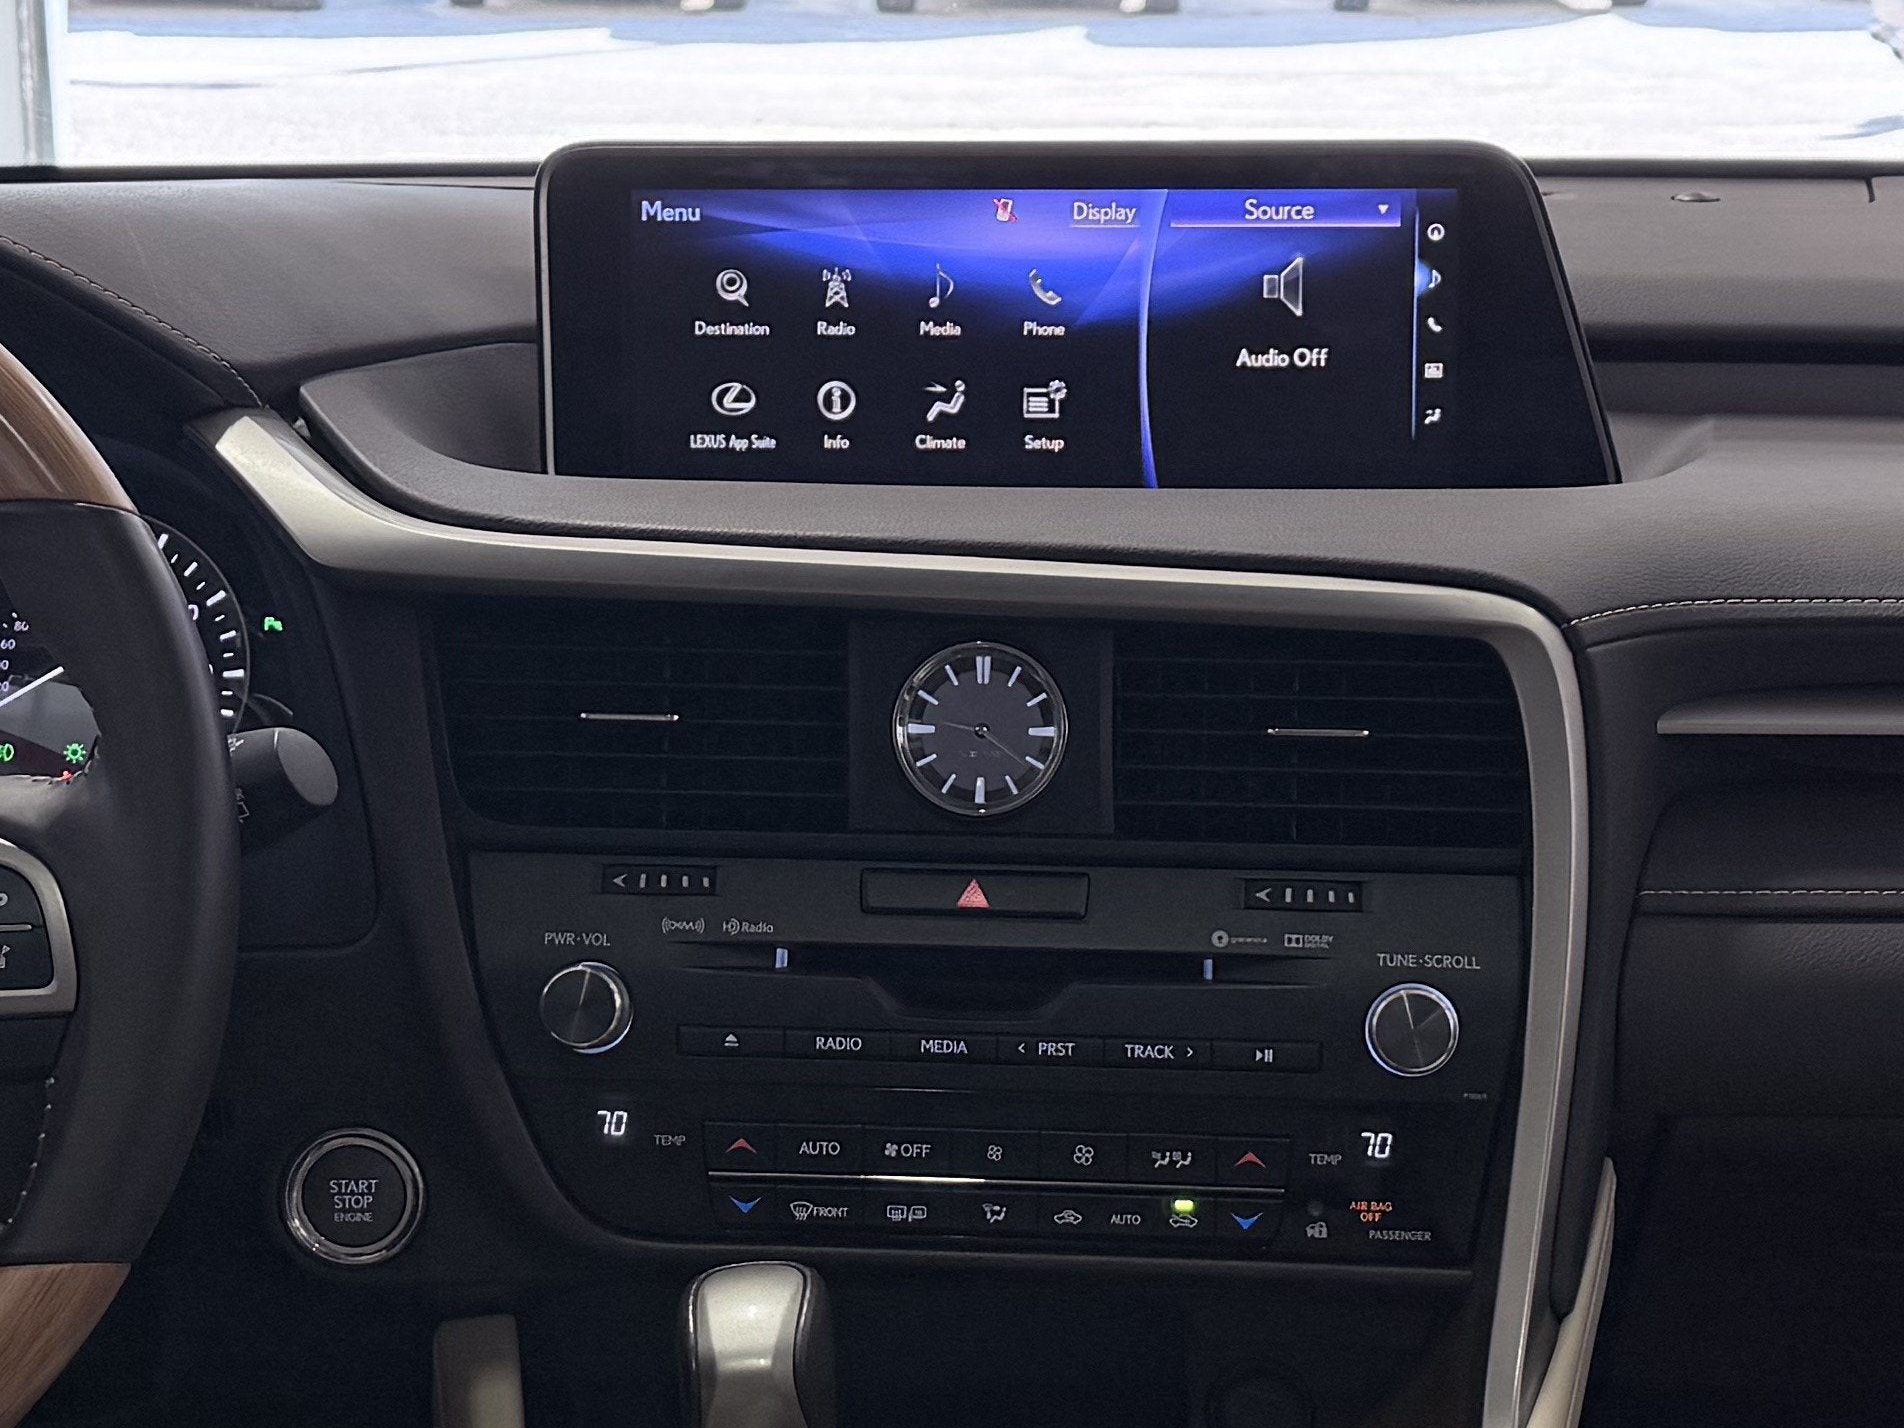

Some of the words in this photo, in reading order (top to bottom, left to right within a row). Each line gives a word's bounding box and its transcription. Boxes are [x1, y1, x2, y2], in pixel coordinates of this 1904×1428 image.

[641, 201, 700, 223] Menu
[1073, 201, 1137, 227] Display
[1244, 201, 1314, 222] Source
[694, 321, 770, 336] Destination
[817, 321, 856, 336] Radio
[920, 321, 962, 336] Media
[1023, 321, 1066, 336] Phone
[1236, 347, 1287, 369] Audio
[1294, 347, 1328, 369] Off
[690, 435, 725, 449] LEXUS
[728, 435, 749, 452] App
[752, 435, 777, 449] Suite
[824, 435, 849, 449] Info
[916, 435, 966, 449] Climate
[1024, 435, 1065, 452] Setup
[0, 638, 16, 650] 60
[742, 922, 773, 933] Radio
[816, 1036, 862, 1051] RADIO
[920, 1039, 968, 1054] MEDIA
[1038, 1042, 1075, 1057] PRST
[1125, 1044, 1174, 1059] TRACK
[598, 1111, 628, 1135] 70
[654, 1134, 686, 1146] TEMP
[1361, 1132, 1392, 1159] 70
[799, 1142, 840, 1155] AUTO
[901, 1144, 931, 1157] OFF
[1309, 1153, 1341, 1165] TEMP
[329, 1179, 379, 1193] START
[334, 1194, 373, 1209] STOP
[1350, 1201, 1367, 1213] AIR
[1370, 1201, 1392, 1213] BAG
[334, 1212, 373, 1222] ENGINE
[813, 1207, 848, 1218] FRONT
[1110, 1214, 1141, 1225] AUTO
[1360, 1212, 1382, 1223] OFF
[1369, 1230, 1431, 1242] PASSENGER
